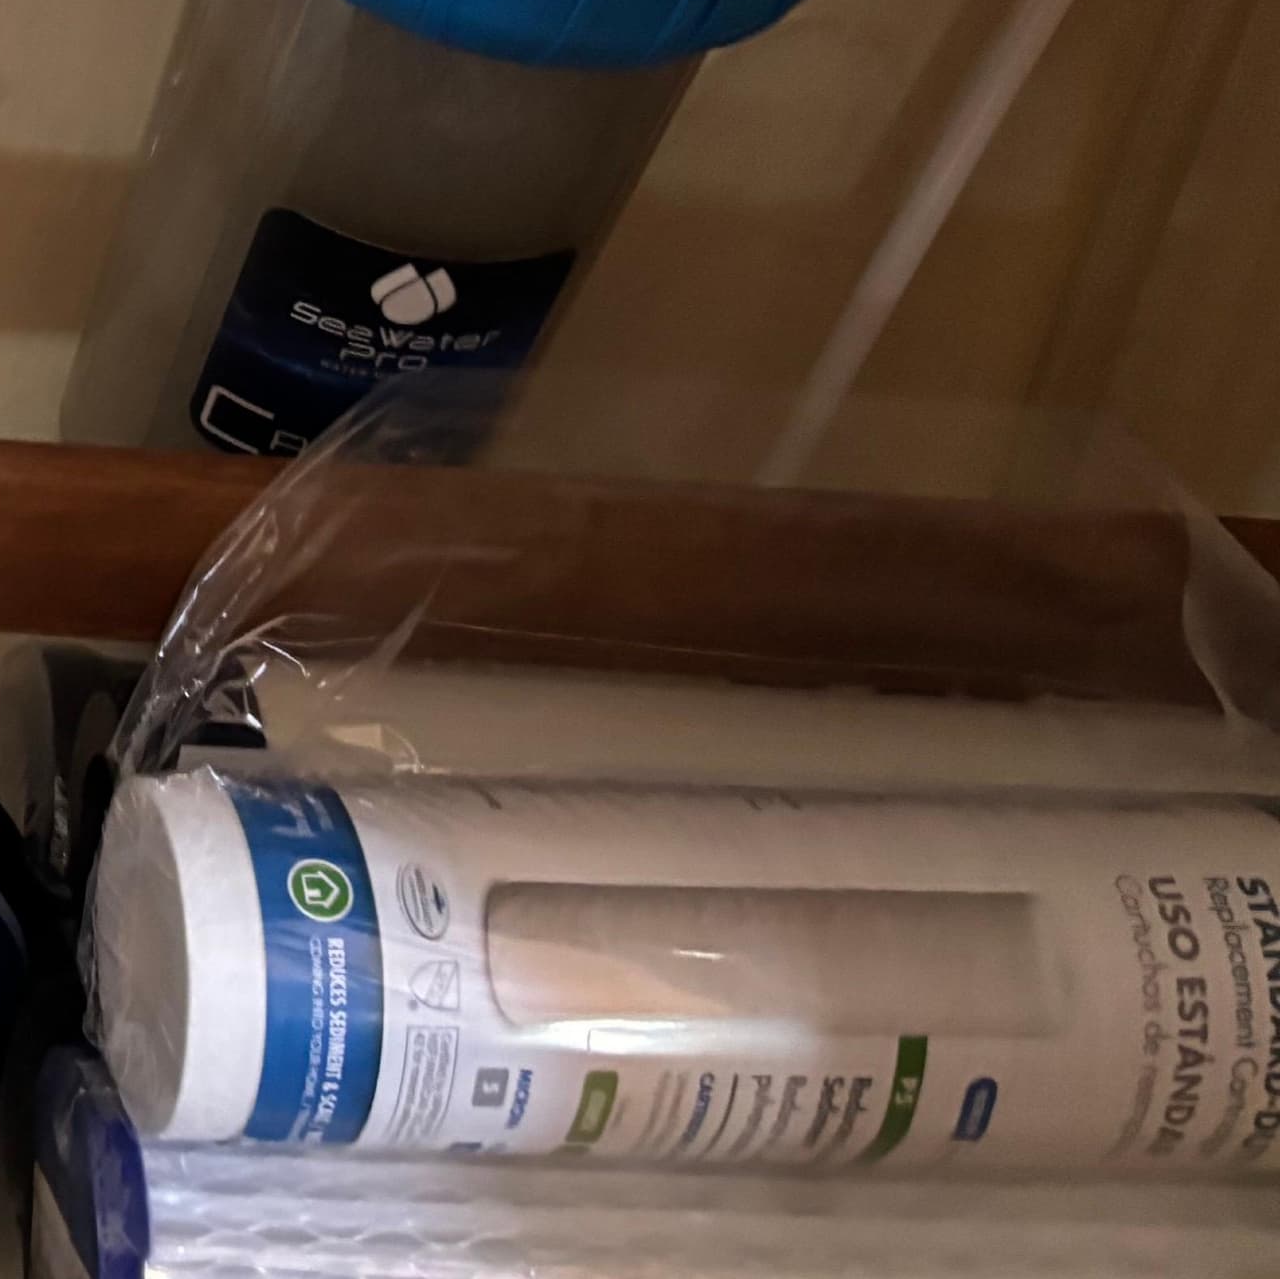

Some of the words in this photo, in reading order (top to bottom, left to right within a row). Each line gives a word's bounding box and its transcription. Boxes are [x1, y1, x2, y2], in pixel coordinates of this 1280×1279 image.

[290, 300, 503, 352] SeaWater
[1148, 875, 1200, 961] USO
[327, 937, 345, 1009] REDUCES
[1204, 877, 1256, 1049] Replacement
[325, 1007, 346, 1079] SEDIMENT
